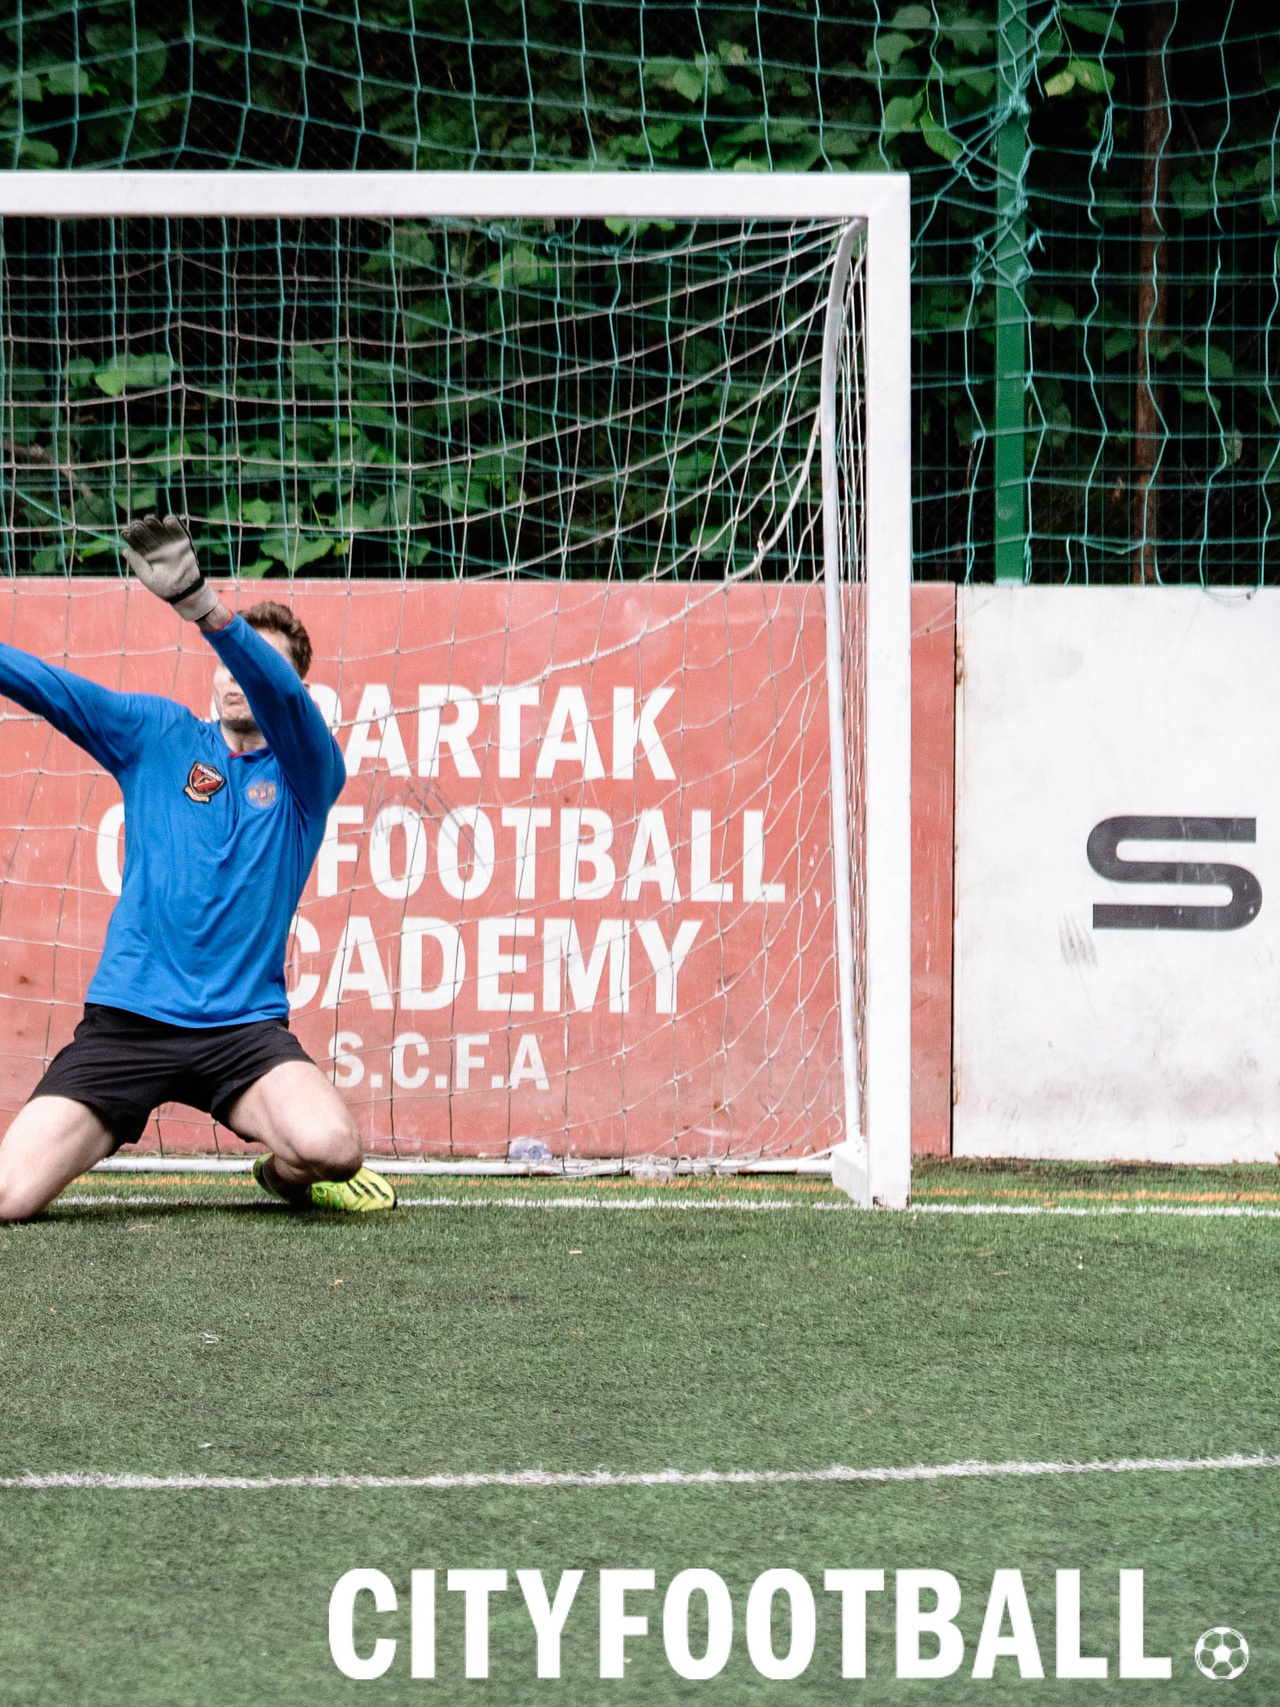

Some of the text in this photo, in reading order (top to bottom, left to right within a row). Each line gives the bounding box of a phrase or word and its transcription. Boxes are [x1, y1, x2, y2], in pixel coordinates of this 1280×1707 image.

[1086, 815, 1263, 932] S
[286, 916, 703, 1014] CADEMY
[326, 1030, 551, 1091] S.C.F.A
